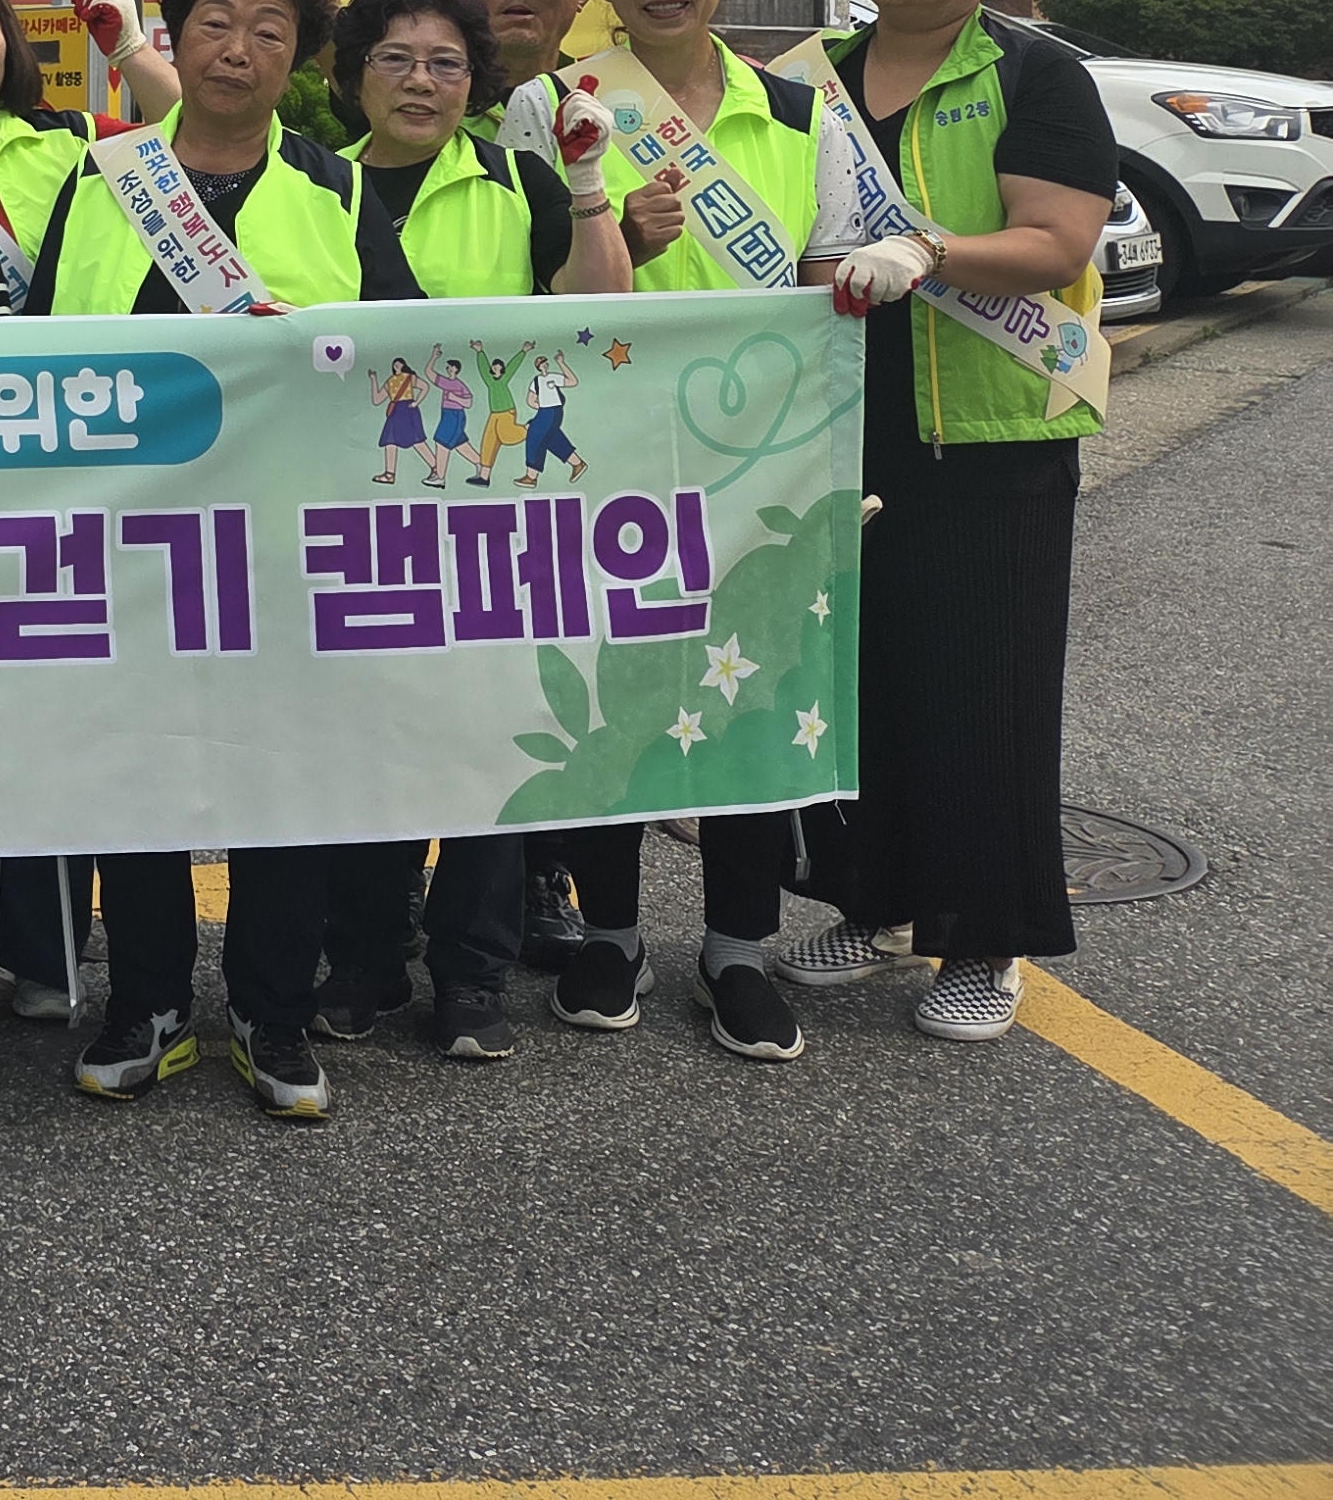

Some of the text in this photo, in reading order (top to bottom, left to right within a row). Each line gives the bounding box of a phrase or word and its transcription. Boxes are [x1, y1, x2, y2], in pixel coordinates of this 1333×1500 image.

[55, 71, 83, 87] 촬영중
[117, 169, 201, 284] 조성을 위한
[135, 137, 181, 195] 깨끗한
[168, 191, 249, 288] 행복도시
[303, 491, 711, 652] 캠페인
